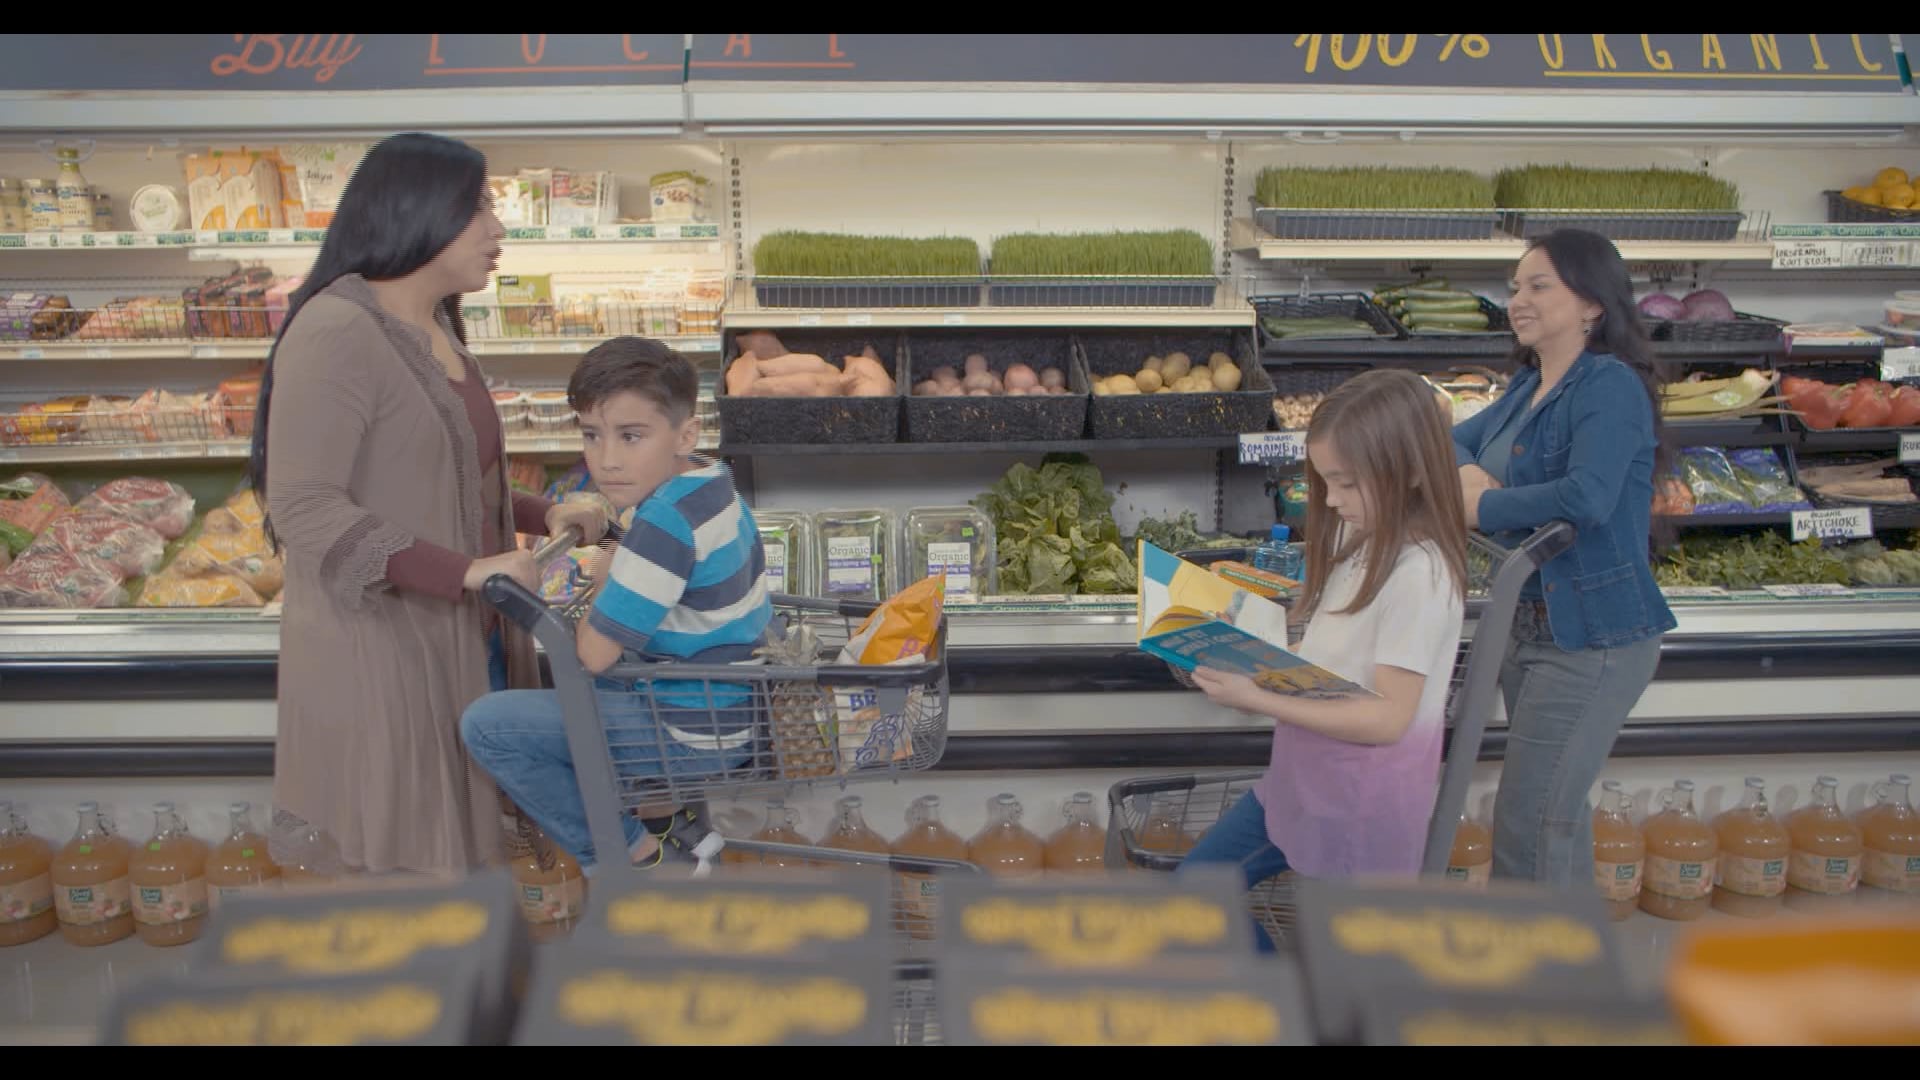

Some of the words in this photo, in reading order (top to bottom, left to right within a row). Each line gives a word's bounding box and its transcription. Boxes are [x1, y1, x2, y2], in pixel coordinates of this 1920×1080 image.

[211, 34, 363, 82] Buy
[1293, 34, 1490, 73] 100%
[1797, 517, 1860, 531] ARTICHOKE
[829, 546, 869, 556] Organic
[928, 552, 969, 561] Organic
